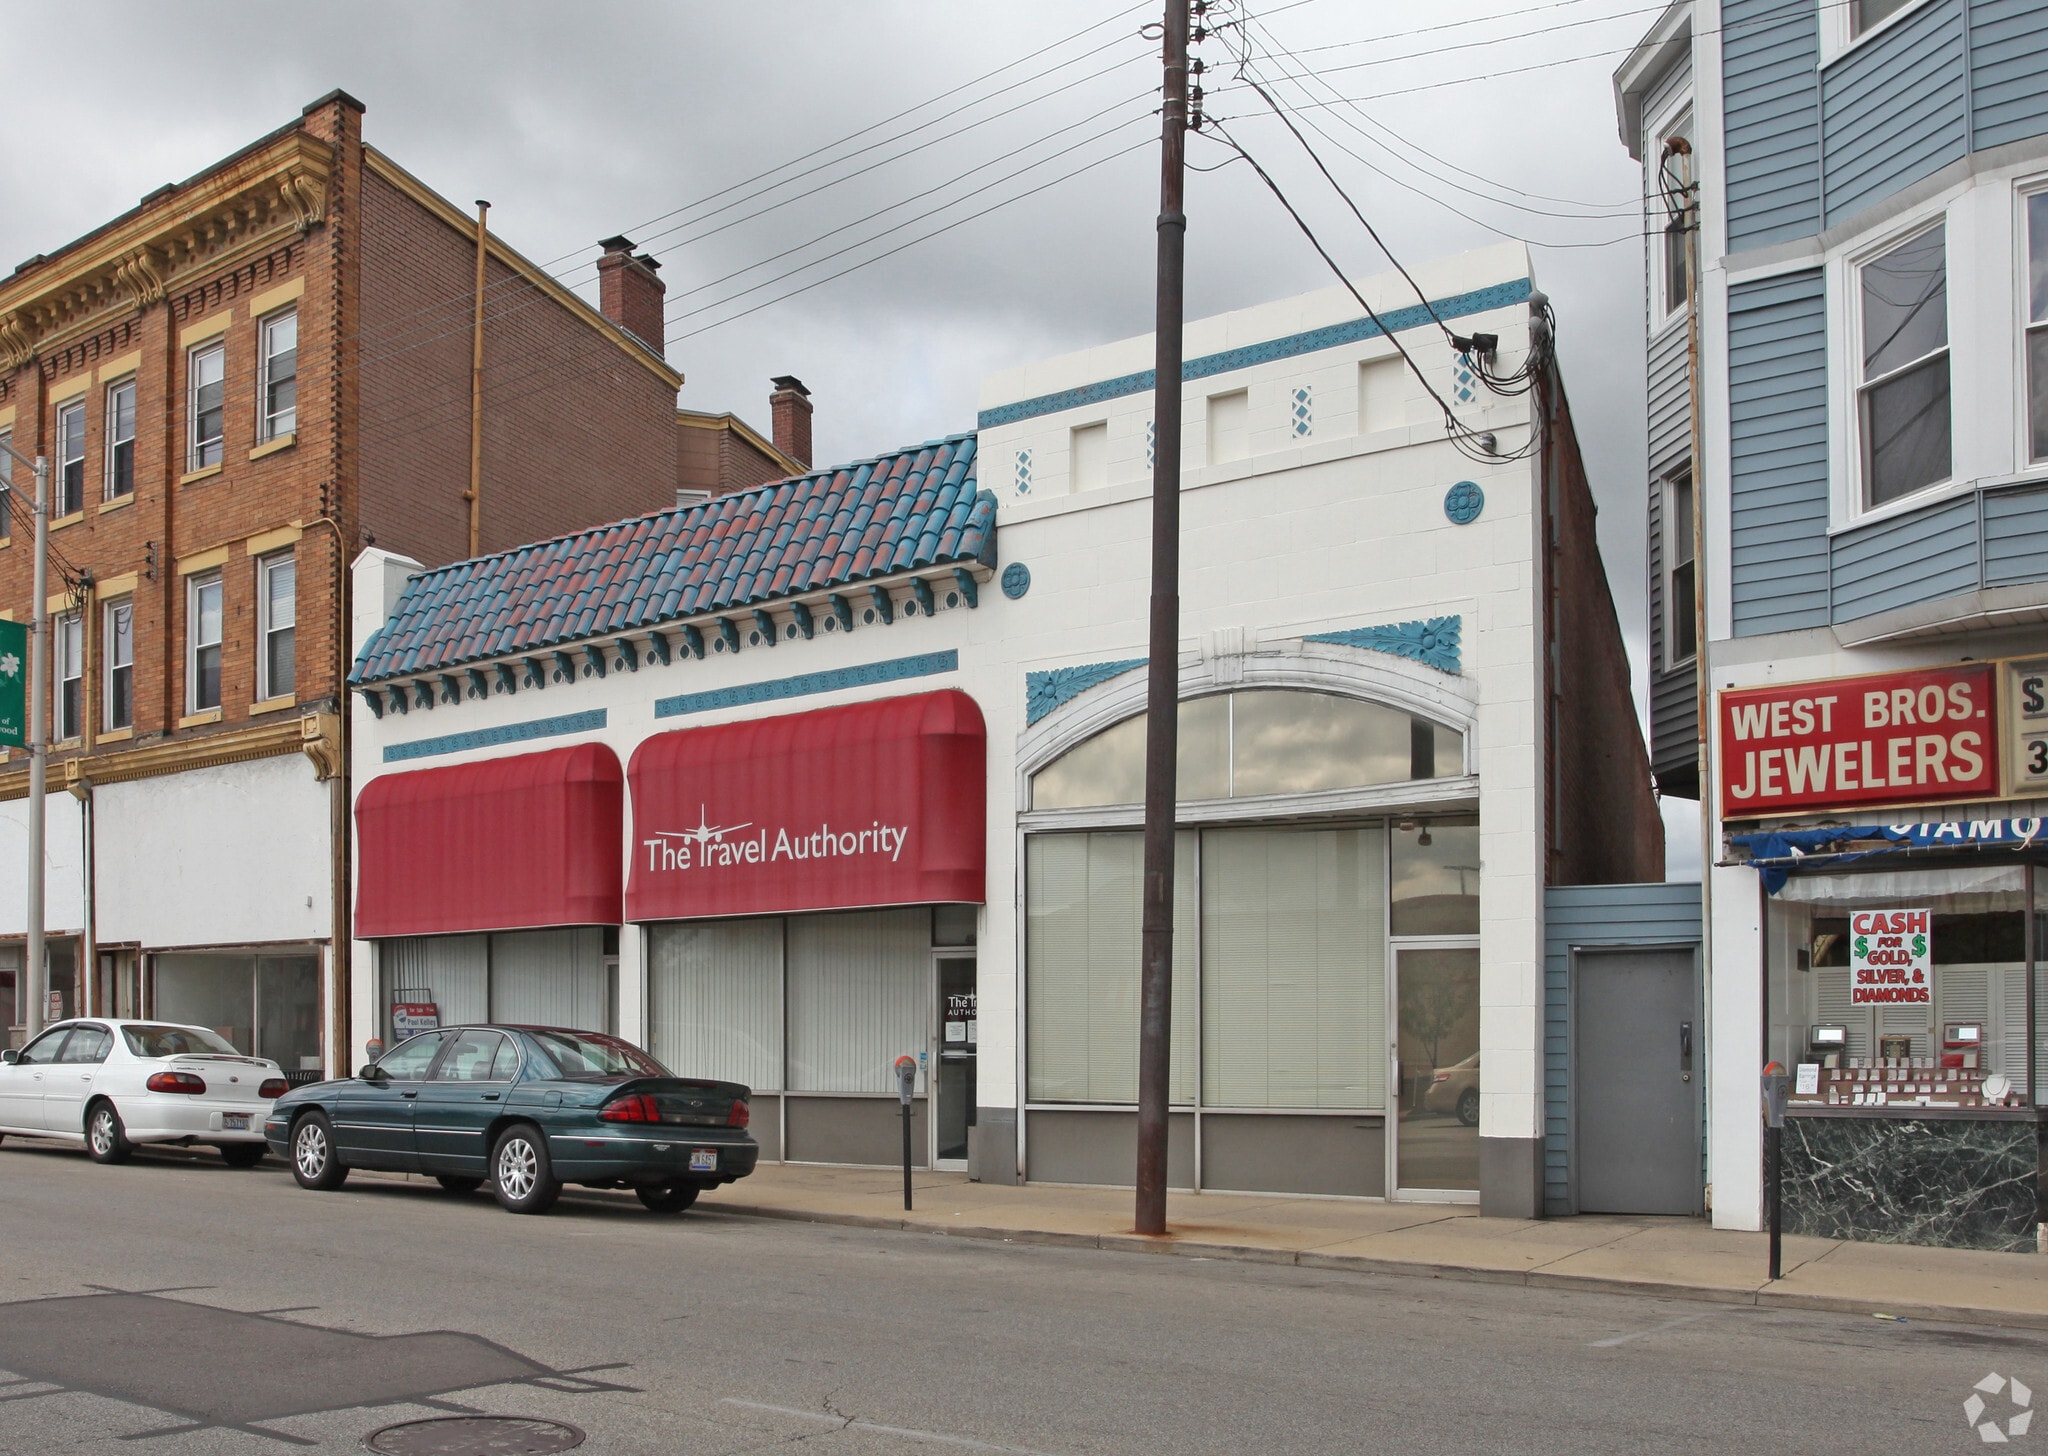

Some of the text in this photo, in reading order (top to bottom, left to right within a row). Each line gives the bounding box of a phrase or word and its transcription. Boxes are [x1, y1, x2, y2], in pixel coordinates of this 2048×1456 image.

[1731, 682, 1986, 741] WEST BROS.
[1, 717, 10, 725] of
[0, 726, 17, 735] ood
[1731, 730, 1984, 799] JEWELERS
[2028, 740, 2048, 774] 3
[643, 821, 908, 871] The Travel Authority
[1853, 912, 1927, 935] CASH
[1877, 937, 1903, 948] FOR
[1867, 950, 1913, 966] GOLD,
[1857, 968, 1924, 985] SILVER, &
[948, 996, 968, 1008] The
[1853, 987, 1929, 1003] DIAMONDS
